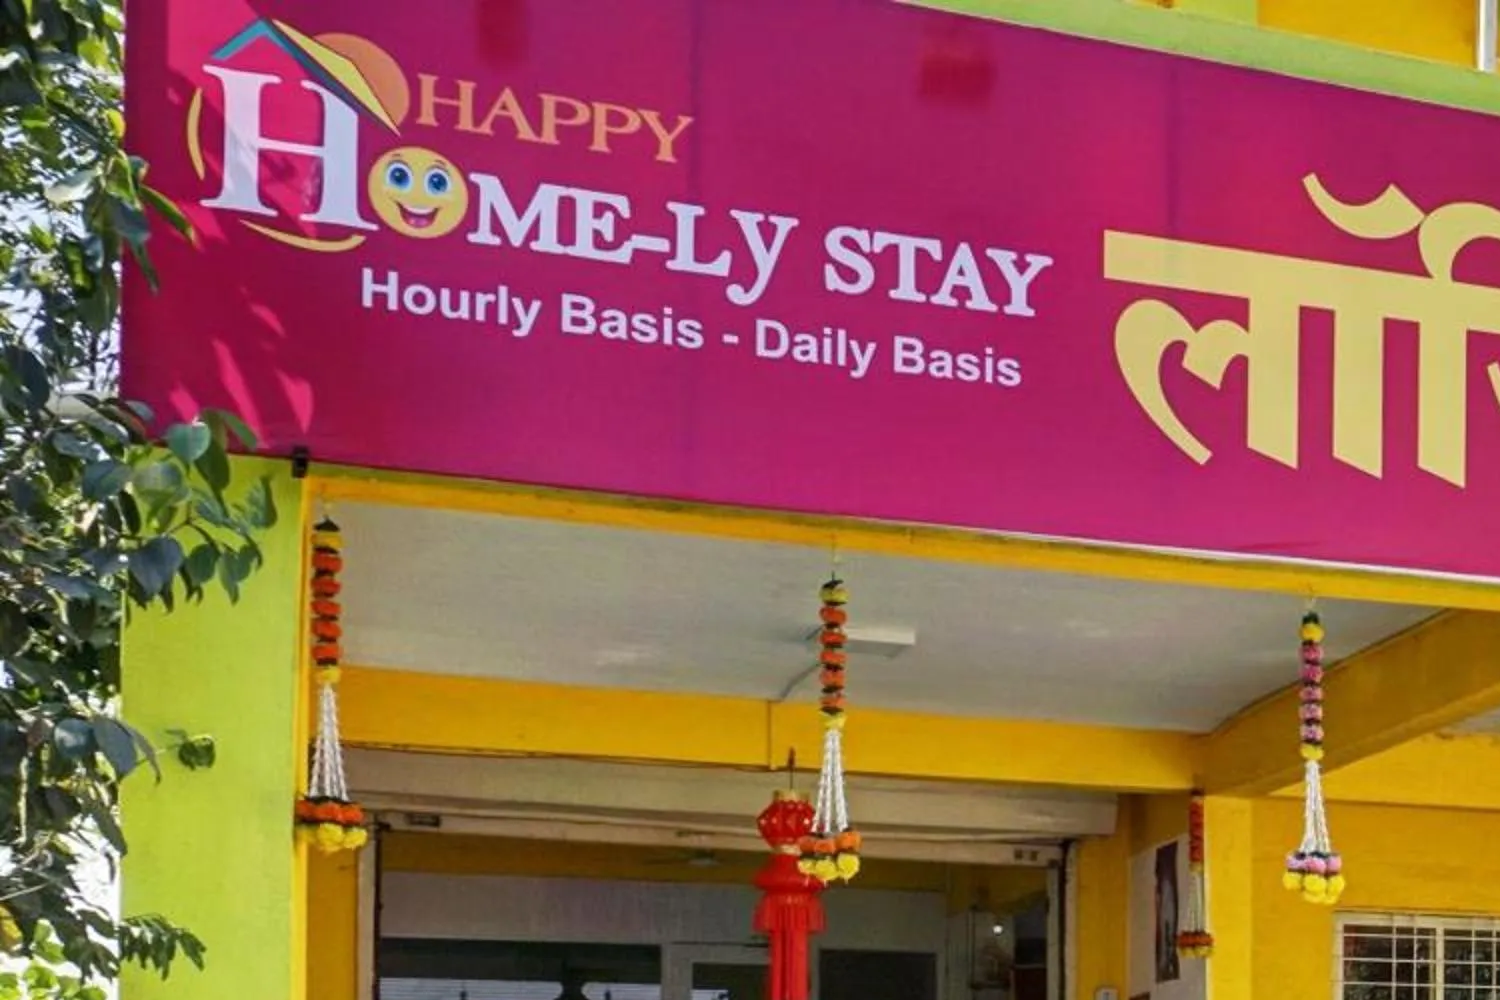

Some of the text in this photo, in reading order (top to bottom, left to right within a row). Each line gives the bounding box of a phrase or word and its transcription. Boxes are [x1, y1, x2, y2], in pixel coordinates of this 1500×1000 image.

[415, 73, 694, 164] HAPPY
[823, 226, 1053, 318] STAY
[361, 267, 541, 339] Hourly
[560, 292, 705, 350] Basis
[755, 318, 877, 378] Daily
[893, 336, 1022, 388] Basis
